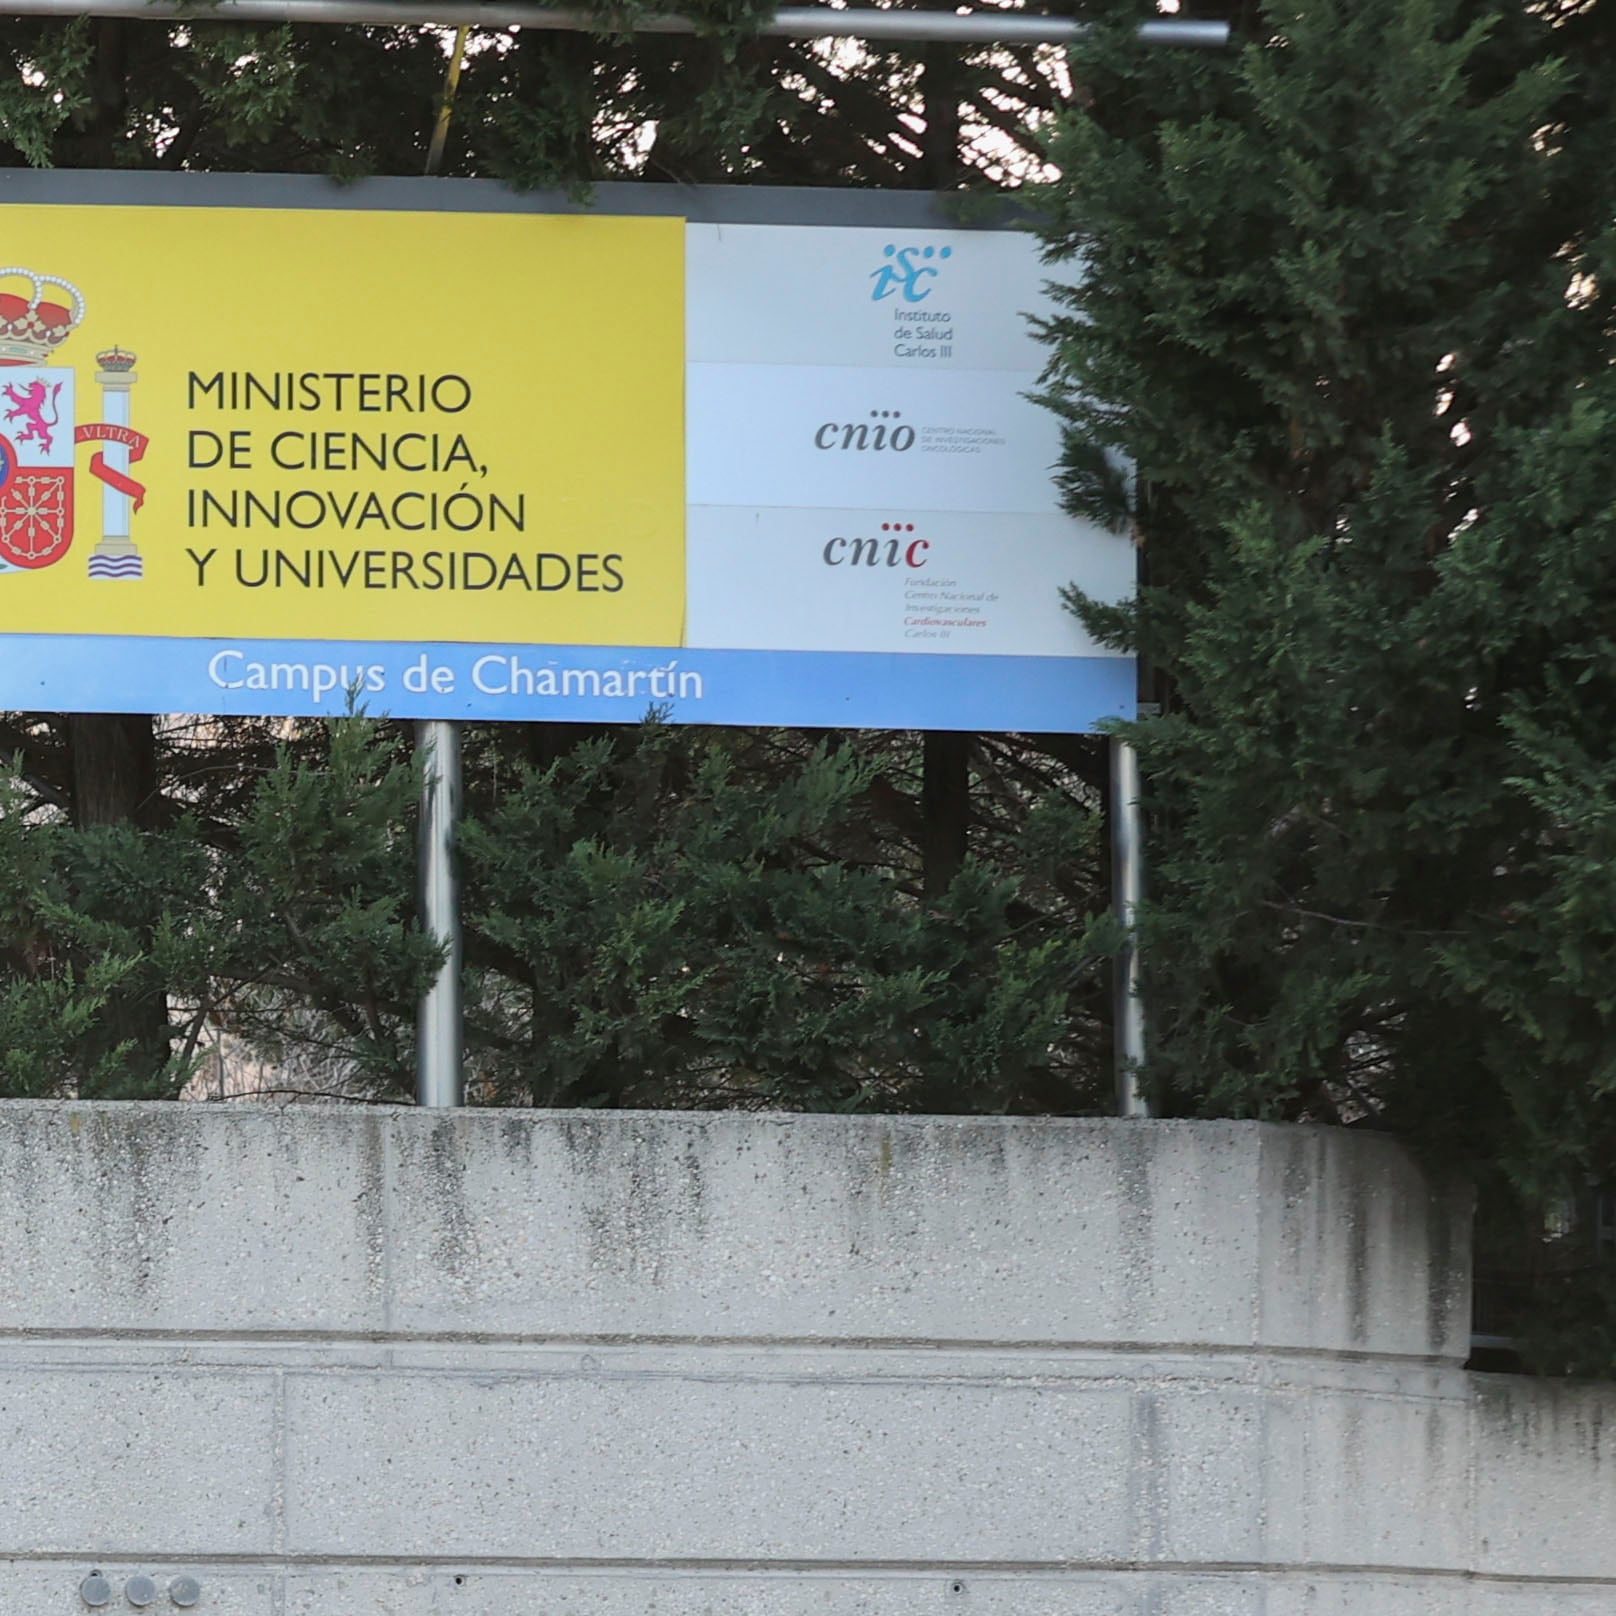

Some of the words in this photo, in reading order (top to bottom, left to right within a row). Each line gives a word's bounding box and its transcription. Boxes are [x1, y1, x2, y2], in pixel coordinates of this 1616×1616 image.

[894, 308, 951, 322] Instituto
[894, 327, 912, 340] de
[917, 326, 953, 341] Salud
[894, 344, 936, 357] Carlos
[940, 345, 952, 357] III
[187, 371, 472, 414] MINISTERIO
[187, 430, 253, 470] DE
[270, 431, 489, 478] CIENCIA,
[187, 482, 526, 532] INNOVACIÓN
[185, 548, 218, 588] Y
[234, 548, 625, 593] UNIVERSIDADES
[208, 649, 385, 703] Campus
[403, 653, 455, 695] de
[472, 654, 704, 699] Chamartín
